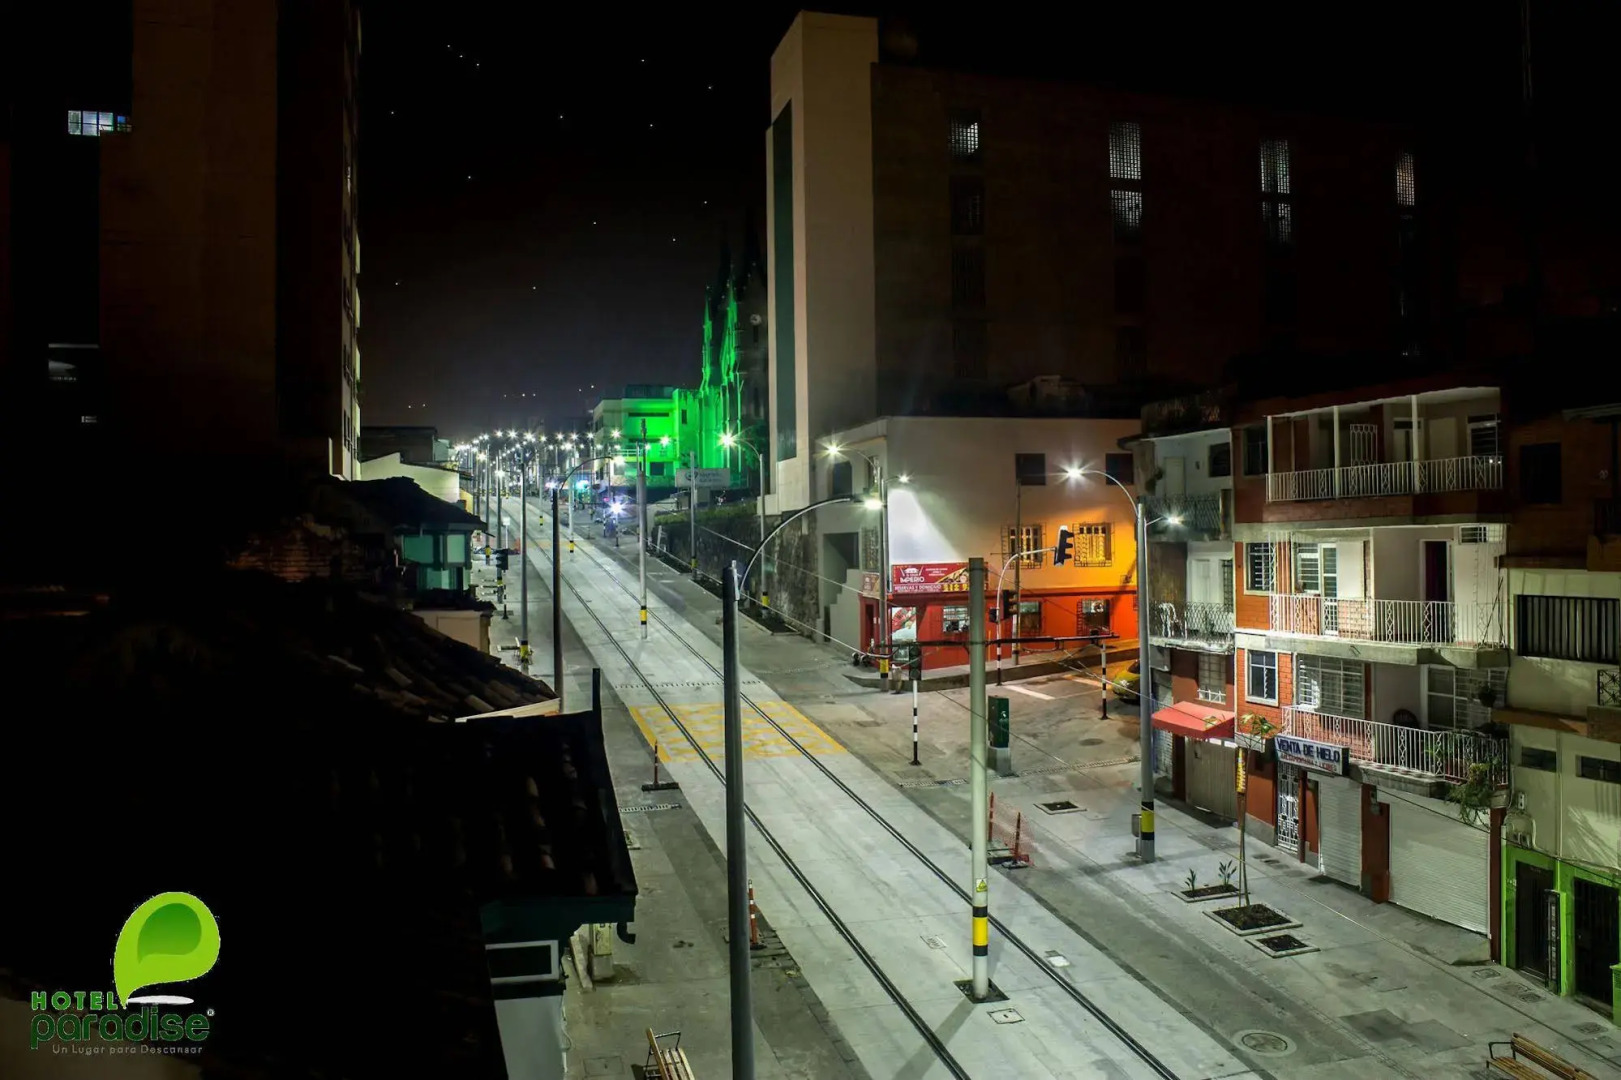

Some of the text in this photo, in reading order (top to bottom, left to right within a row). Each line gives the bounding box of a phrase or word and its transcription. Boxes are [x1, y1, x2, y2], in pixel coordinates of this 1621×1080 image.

[1277, 738, 1301, 755] VENTA
[1303, 743, 1314, 756] DE
[1316, 746, 1340, 763] HIELO
